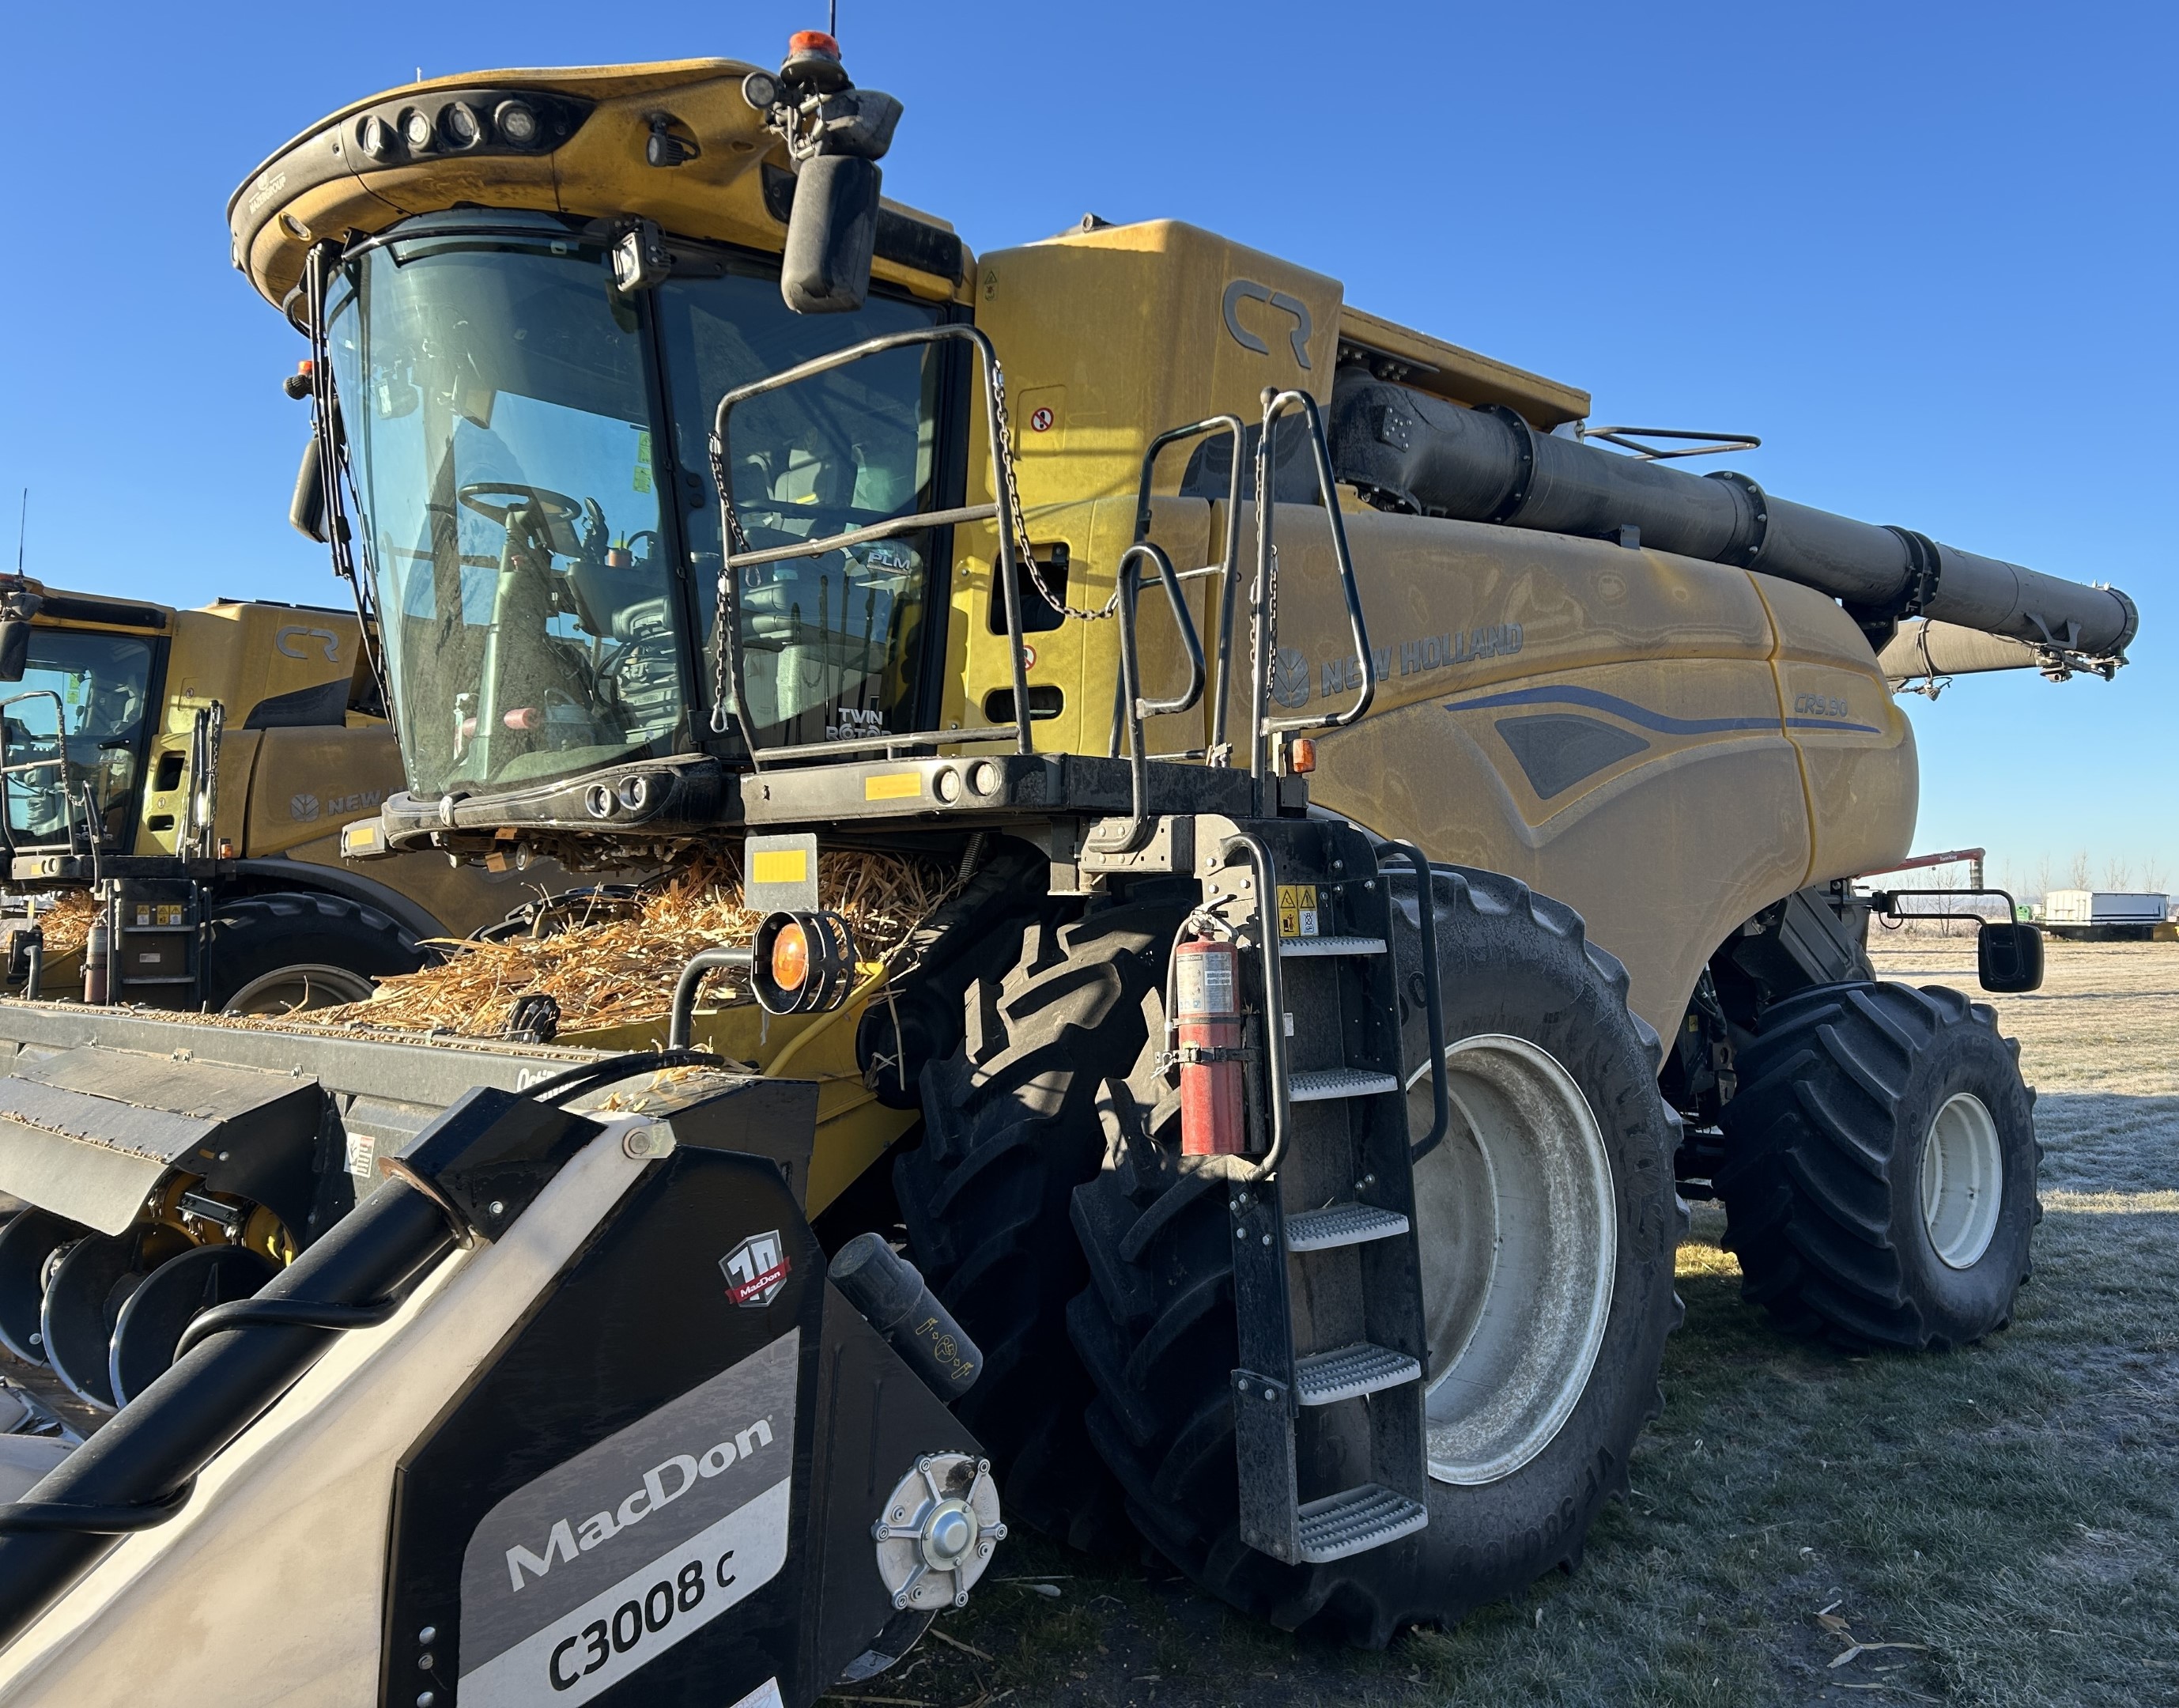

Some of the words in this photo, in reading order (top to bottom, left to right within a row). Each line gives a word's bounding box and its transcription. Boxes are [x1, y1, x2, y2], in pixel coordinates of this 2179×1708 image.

[1222, 279, 1312, 370] CR
[867, 553, 911, 570] PLM
[276, 625, 339, 663] CR
[1400, 622, 1523, 676] HOLLAND
[838, 707, 883, 725] TWIN
[1794, 693, 1849, 717] CR9.90
[328, 789, 381, 816] NEW
[740, 1271, 781, 1298] MacDon
[505, 1419, 772, 1593] MacDon
[549, 1560, 705, 1691] C3008
